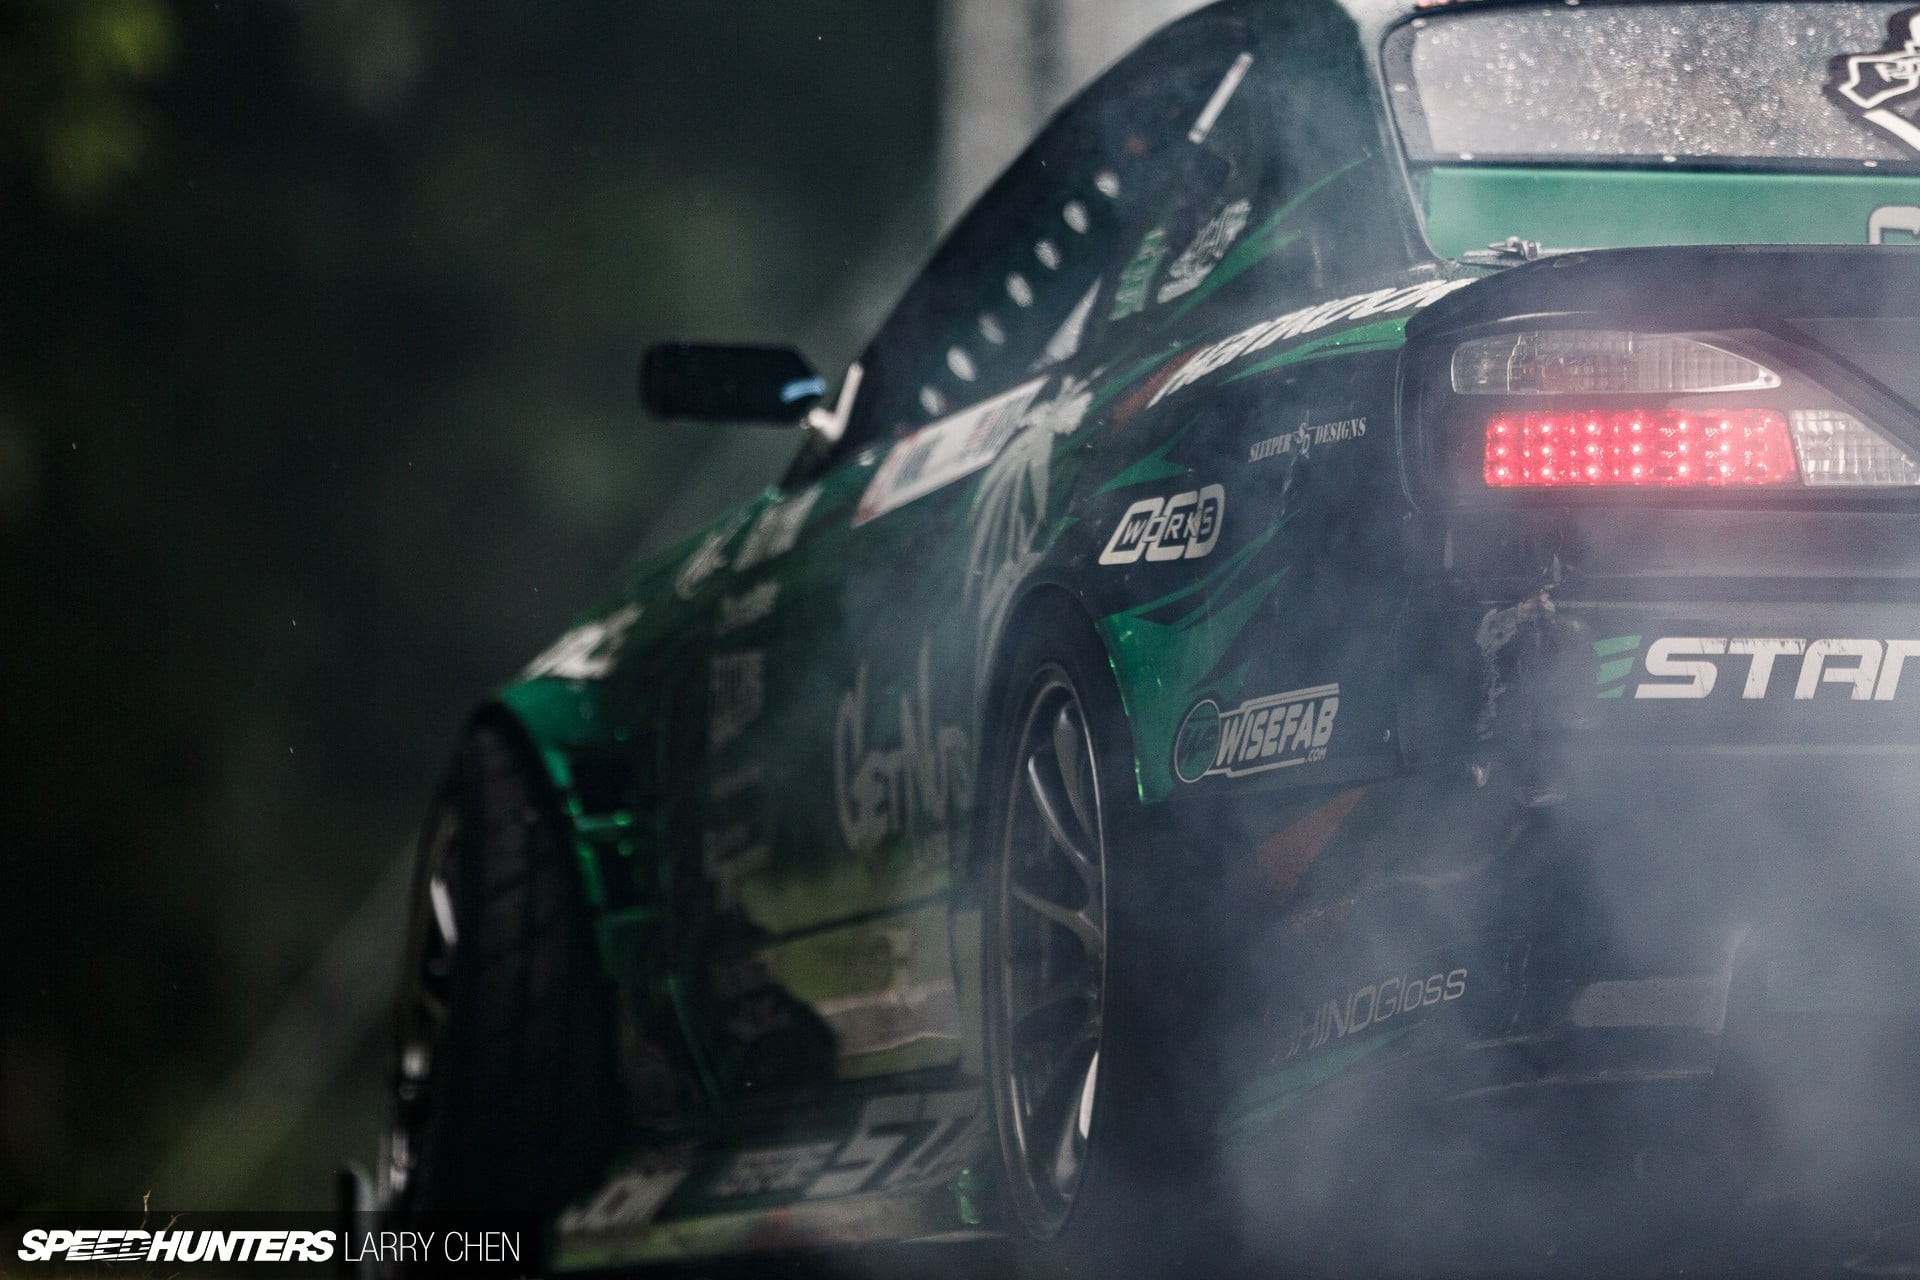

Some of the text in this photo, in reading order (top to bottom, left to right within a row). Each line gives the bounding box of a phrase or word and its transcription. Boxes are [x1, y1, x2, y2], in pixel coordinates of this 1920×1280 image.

[1249, 434, 1291, 463] SLEEPER
[1314, 416, 1367, 446] DESIGNS
[1097, 482, 1226, 566] OCD
[1119, 505, 1215, 546] WORKS
[1216, 696, 1340, 767] WISEFAB
